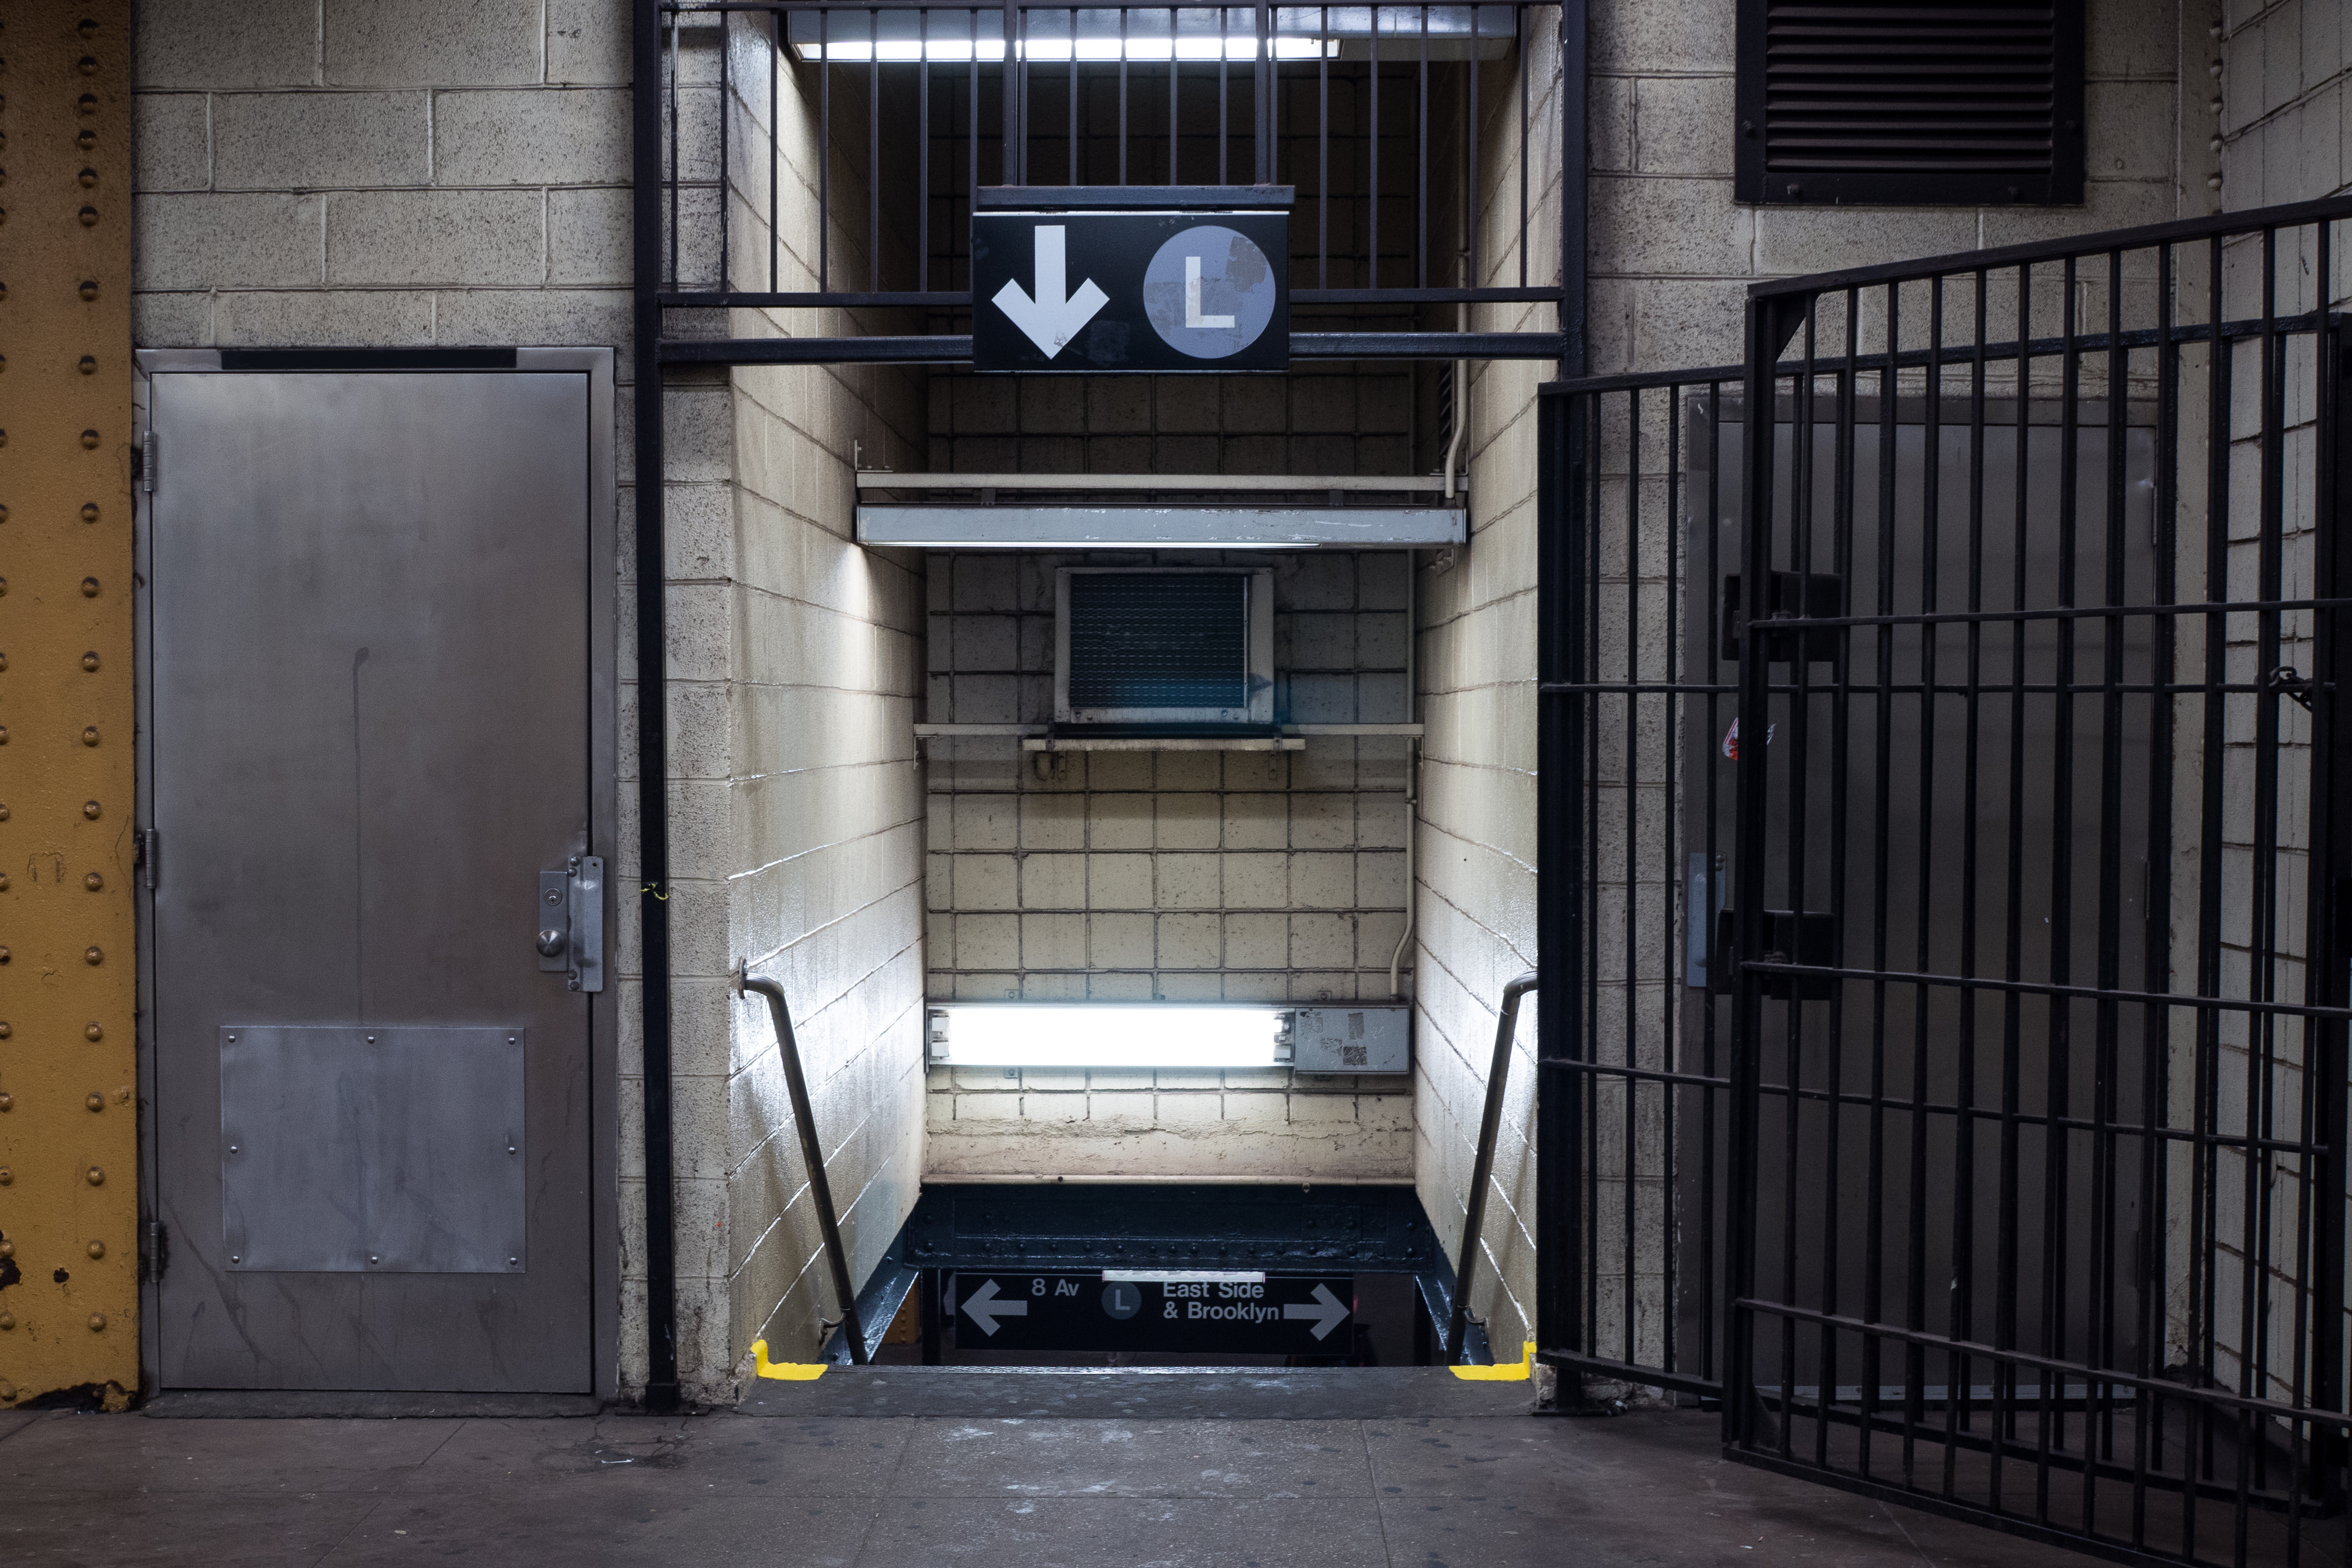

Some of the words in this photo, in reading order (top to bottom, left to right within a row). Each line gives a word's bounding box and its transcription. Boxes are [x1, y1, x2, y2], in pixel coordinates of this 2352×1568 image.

[1185, 256, 1235, 328] L
[1031, 1278, 1046, 1296] 8
[1054, 1279, 1079, 1296] Av
[1163, 1282, 1209, 1298] East
[1218, 1282, 1264, 1298] Side
[1115, 1289, 1130, 1310] L
[1163, 1301, 1179, 1319] &
[1188, 1302, 1279, 1323] Brooklyn
